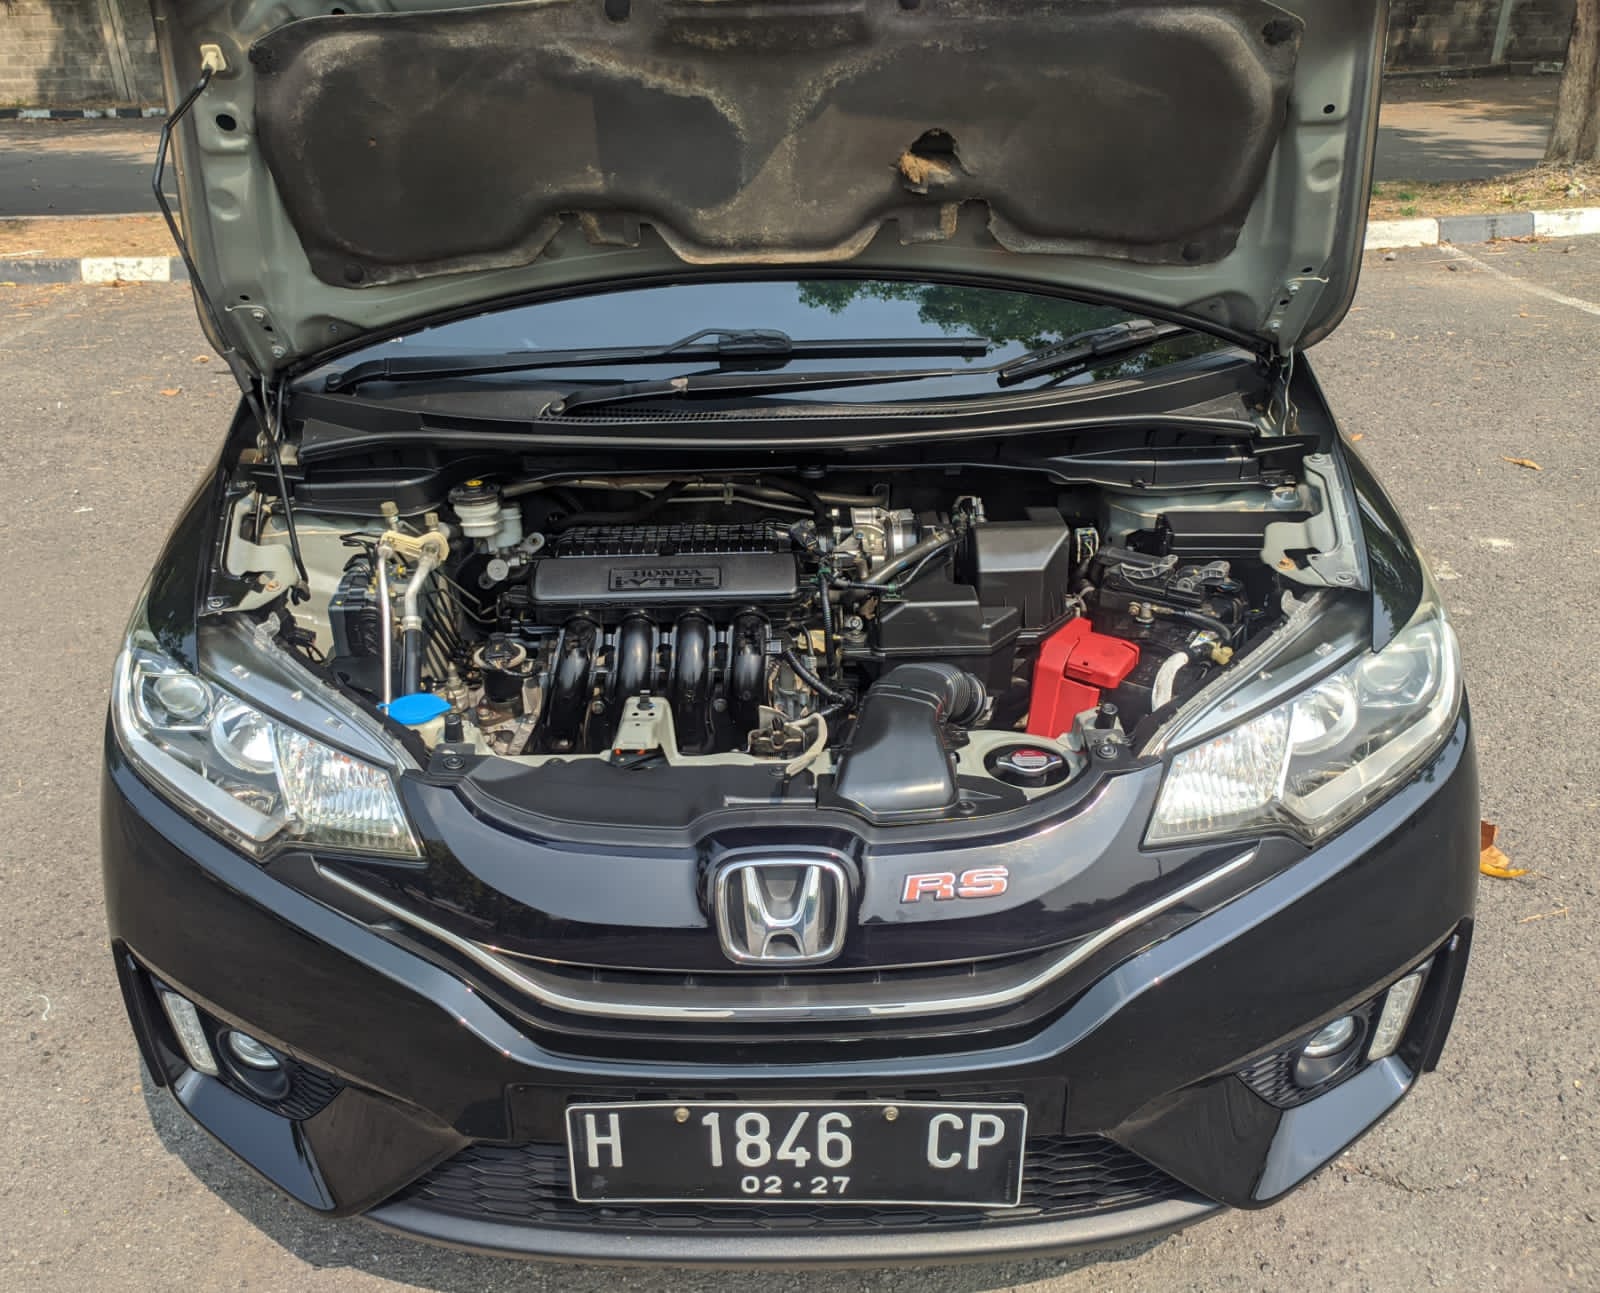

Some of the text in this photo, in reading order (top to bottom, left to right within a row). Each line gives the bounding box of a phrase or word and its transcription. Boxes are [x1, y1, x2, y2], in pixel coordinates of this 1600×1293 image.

[900, 865, 1009, 904] RS
[583, 1111, 1006, 1170] H 1846 CP
